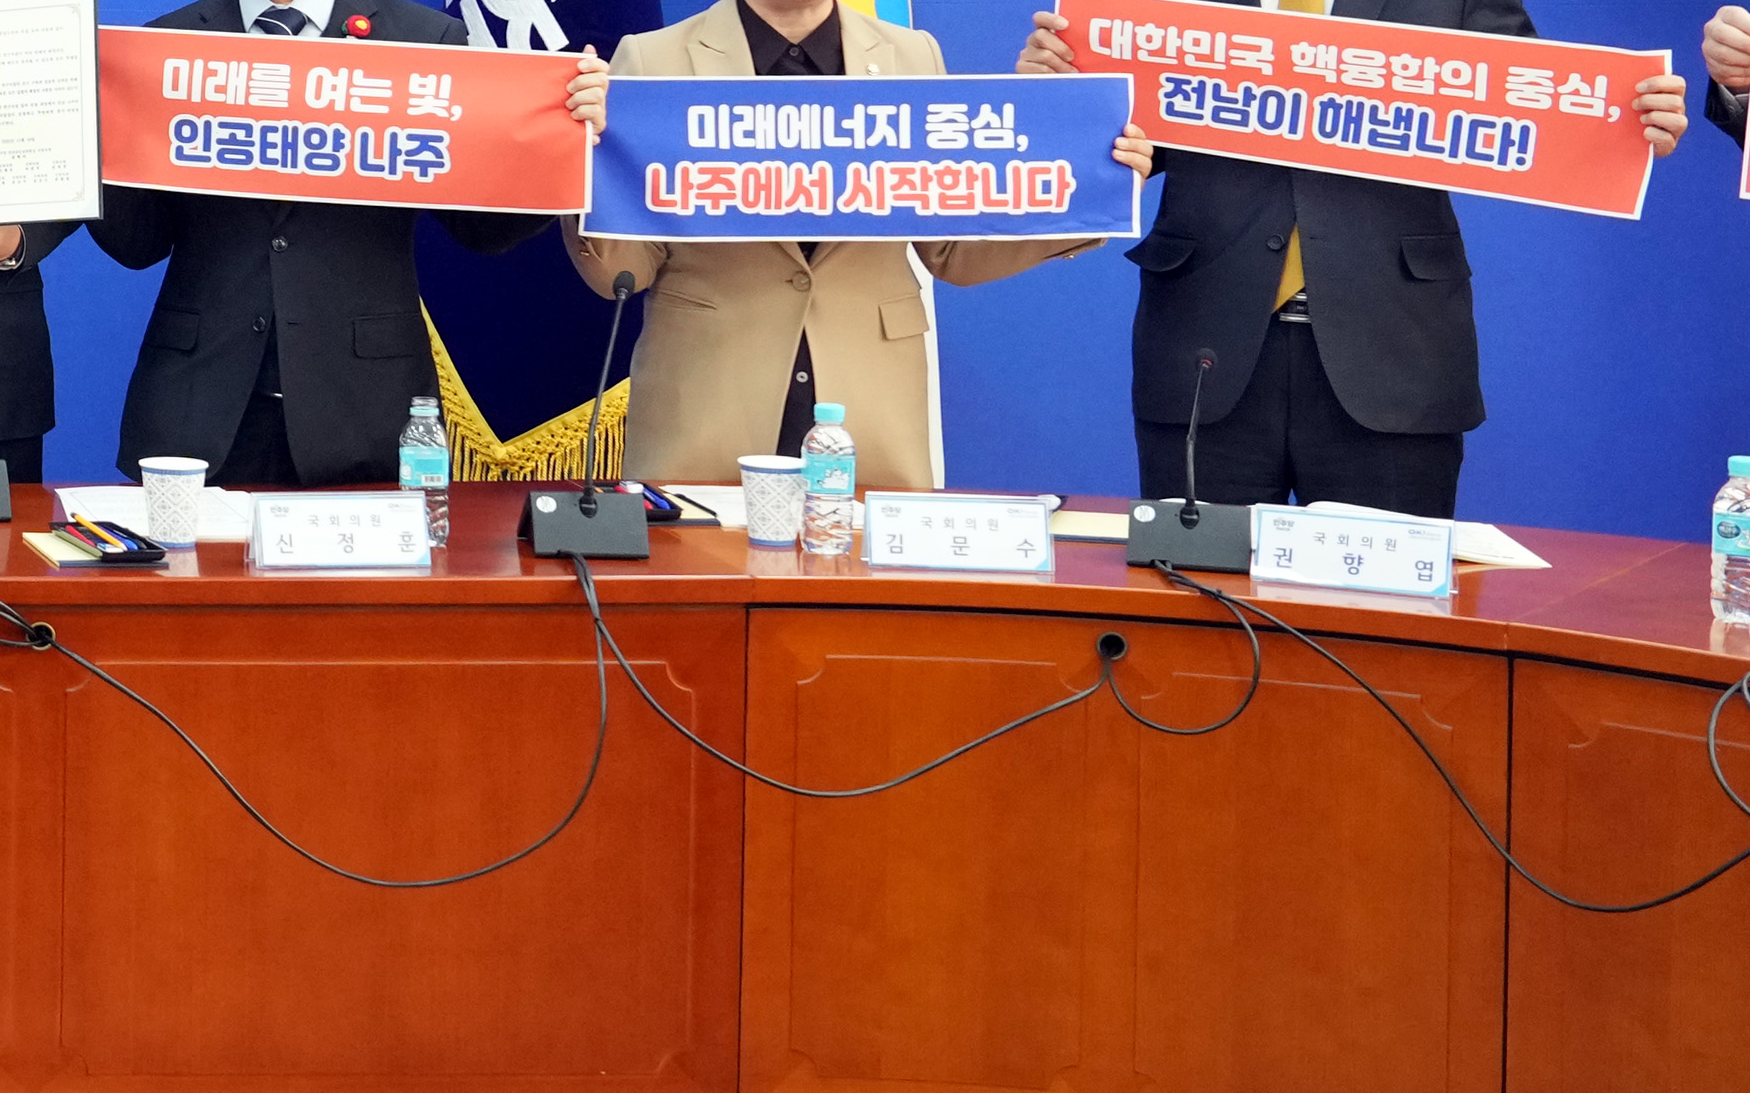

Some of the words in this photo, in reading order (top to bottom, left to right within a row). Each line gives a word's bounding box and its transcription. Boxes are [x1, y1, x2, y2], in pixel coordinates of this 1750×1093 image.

[161, 57, 293, 109] 미래를
[303, 65, 394, 115] 여는
[405, 71, 464, 123] 빛,
[1087, 16, 1276, 77] 대한민국
[1289, 40, 1489, 103] 핵융합의
[1503, 63, 1623, 124] 중심,
[168, 113, 352, 174] 인공태양
[353, 124, 452, 184] 나주
[685, 102, 912, 150] 미래에너지
[923, 102, 1031, 154] 중심,
[1157, 71, 1308, 138] 전남이
[1314, 92, 1539, 174] 해냅니다!
[644, 159, 835, 217] 나주에서
[839, 159, 1078, 217] 시작합니다
